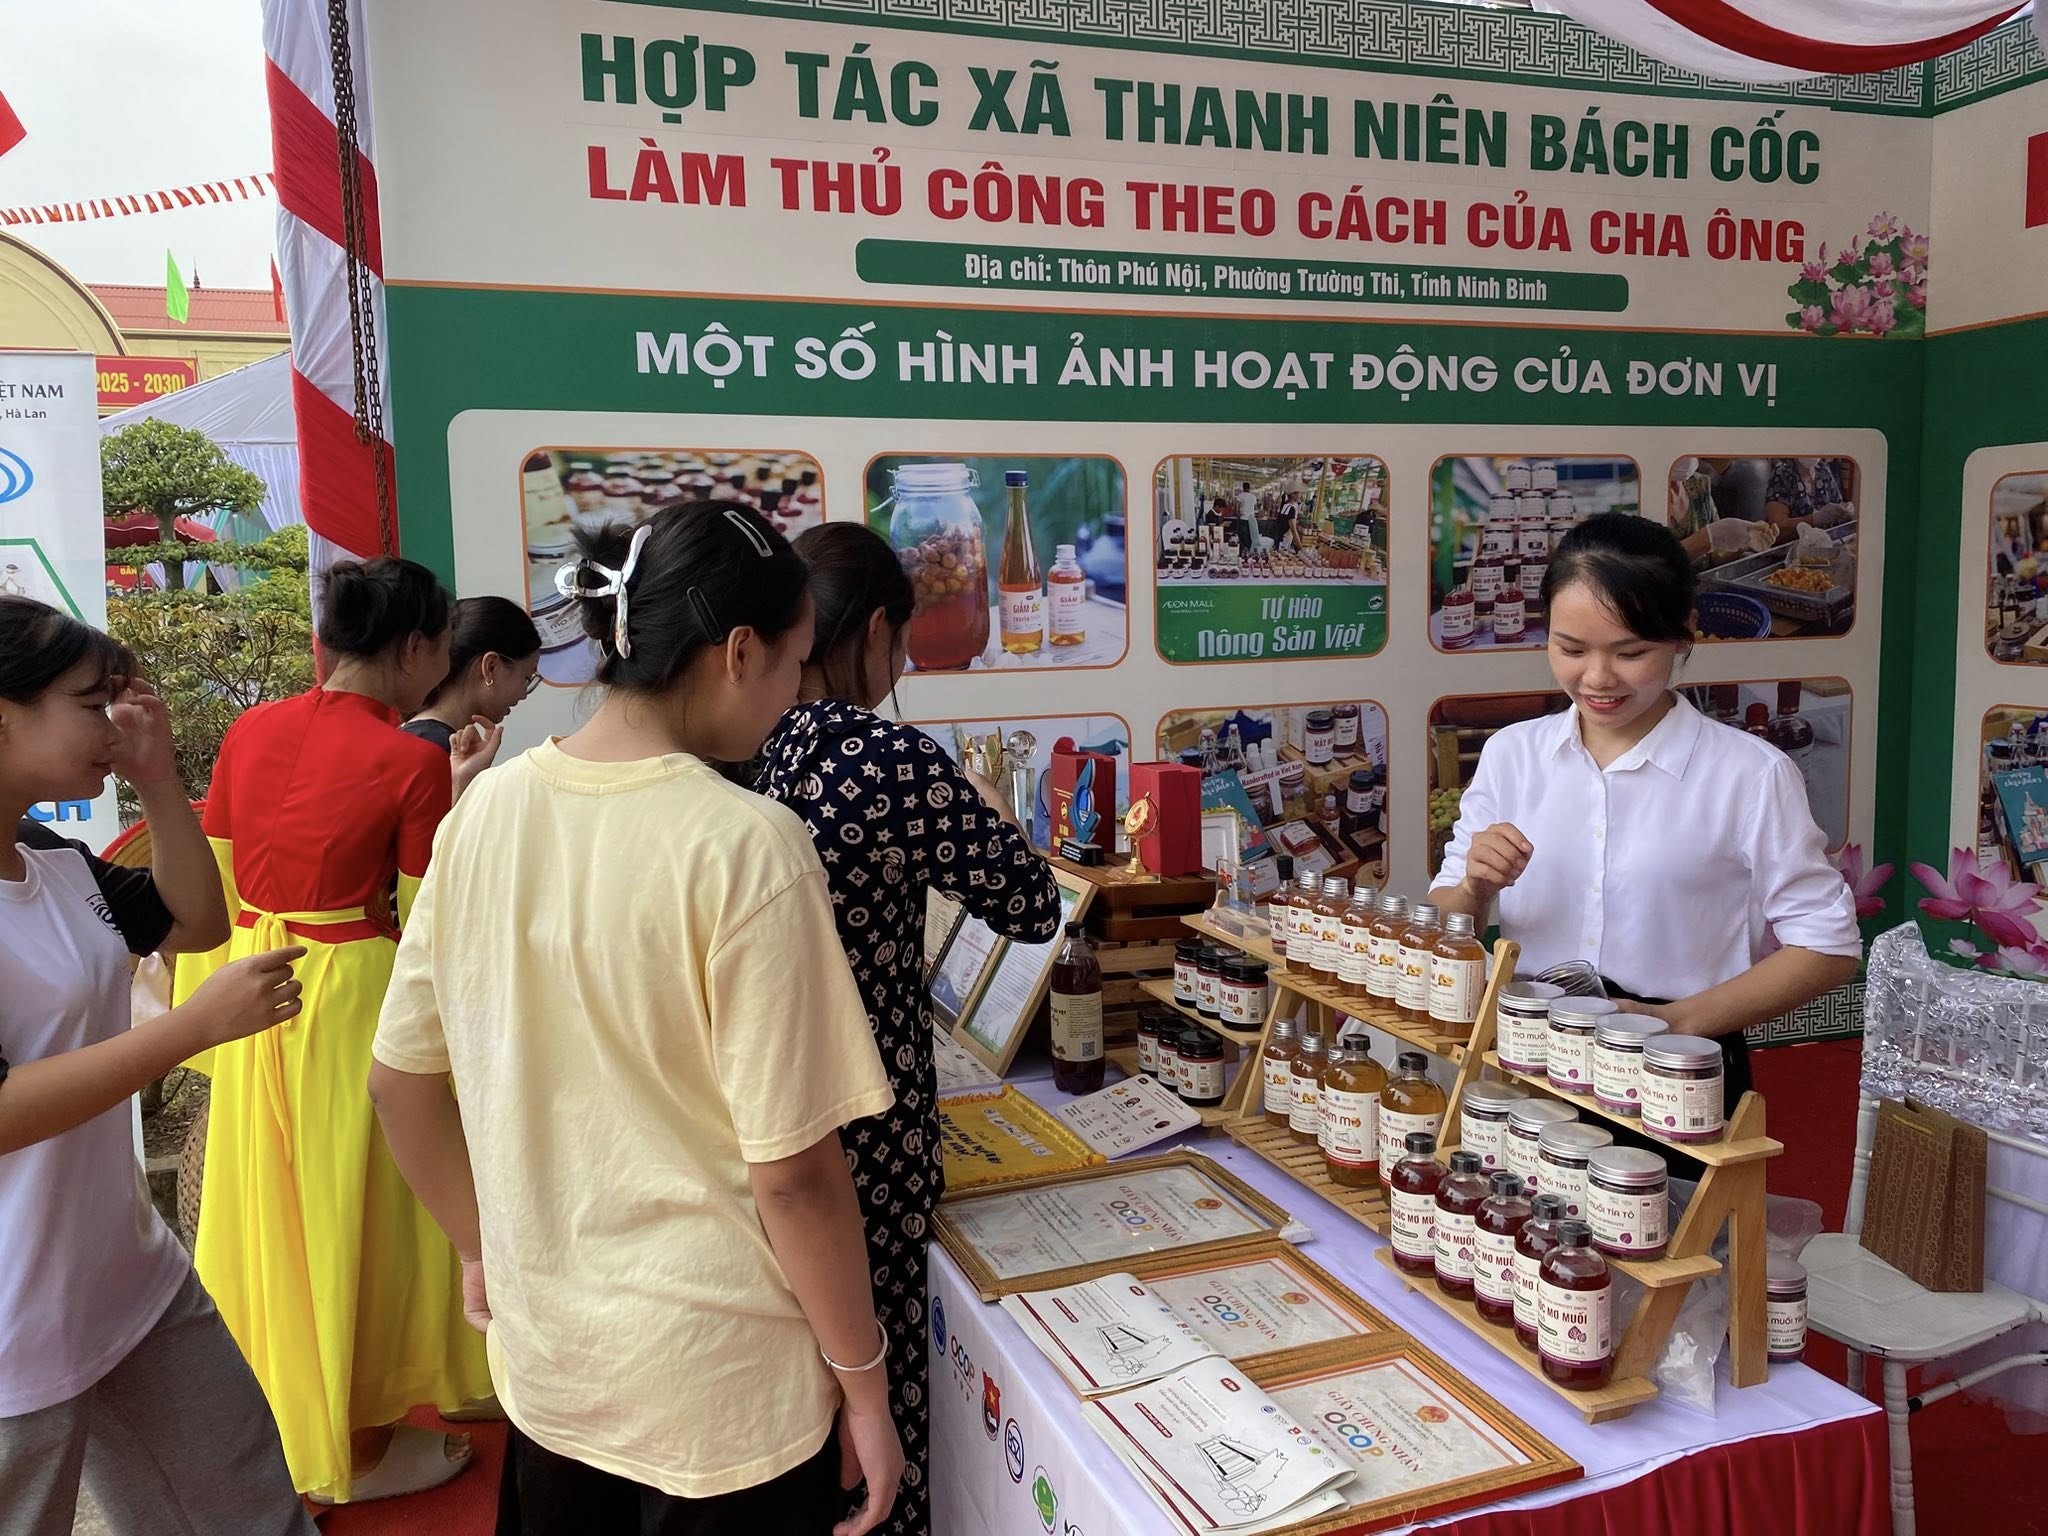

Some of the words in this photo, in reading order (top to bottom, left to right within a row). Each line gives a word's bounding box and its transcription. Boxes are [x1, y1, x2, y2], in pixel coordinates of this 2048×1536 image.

[580, 32, 756, 124] HỢP
[785, 43, 939, 127] TÁC
[967, 59, 1072, 138] XÃ
[1095, 76, 1329, 156] THANH
[1353, 93, 1507, 168] NIÊN
[1530, 105, 1688, 180] BÁCH
[1710, 109, 1820, 185] CỐC
[587, 137, 746, 207] LÀM
[771, 146, 902, 216] THỦ
[927, 160, 1105, 227] CÔNG
[1126, 180, 1275, 237] THEO
[1297, 185, 1447, 245] CÁCH
[1467, 189, 1571, 252] CỦA
[1590, 210, 1689, 257] CHA
[1706, 207, 1804, 263] ÔNG
[964, 253, 1003, 285] Địa
[1010, 253, 1051, 282] chỉ:
[1058, 258, 1111, 284] Thôn
[1118, 260, 1158, 287] Phú
[1165, 262, 1207, 293] Nội,
[1214, 265, 1291, 294] Phường
[1297, 269, 1364, 297] Trường
[1370, 272, 1405, 298] Thi,
[1411, 271, 1451, 298] Tỉnh
[1457, 275, 1500, 300] Ninh
[1506, 277, 1547, 302] Bình
[634, 321, 774, 389] MỘT
[794, 320, 876, 380] SỐ
[898, 329, 1038, 385] HÌNH
[1058, 332, 1174, 388] ẢNH
[1194, 350, 1334, 401] HOẠT
[1350, 344, 1498, 402] ĐỘNG
[1513, 345, 1611, 395] CỦA
[1626, 355, 1723, 397] ĐƠN
[1743, 363, 1777, 408] VỊ
[0, 380, 16, 402] ỆT
[21, 384, 64, 398] NAM
[97, 372, 129, 393] 2025
[6, 408, 21, 419] Hà
[25, 409, 47, 419] Lan
[1260, 595, 1285, 623] TỰ
[1288, 594, 1323, 620] HÀO
[1272, 625, 1316, 652] Sản
[1324, 623, 1365, 651] Việt
[1110, 1200, 1154, 1232] OCOP
[1421, 1215, 1434, 1225] MU
[1496, 1252, 1514, 1266] MUỐ
[1202, 1295, 1249, 1328] OCOP
[1546, 1306, 1560, 1320] MƠ
[1562, 1310, 1588, 1325] MUỐI
[1324, 1411, 1384, 1457] OCOP
